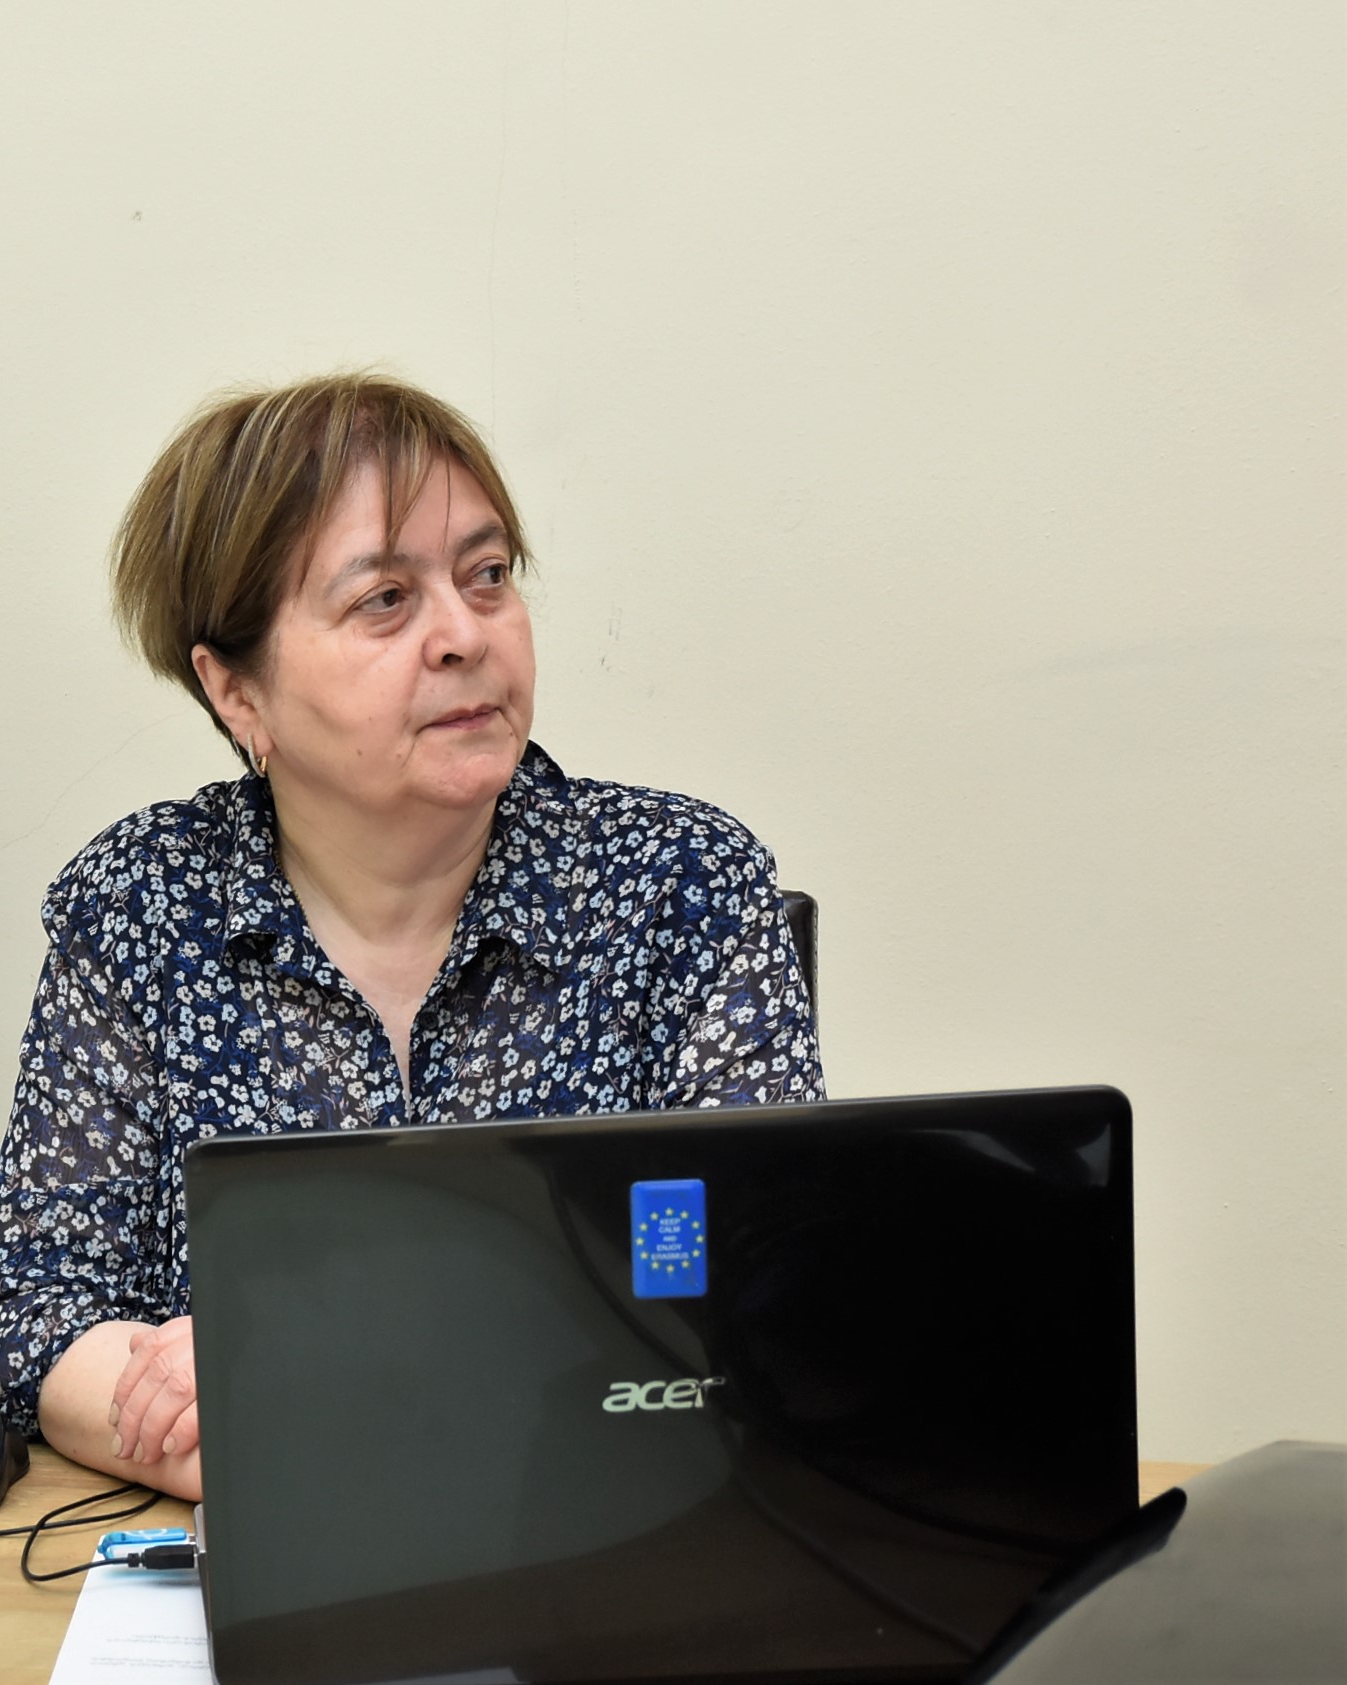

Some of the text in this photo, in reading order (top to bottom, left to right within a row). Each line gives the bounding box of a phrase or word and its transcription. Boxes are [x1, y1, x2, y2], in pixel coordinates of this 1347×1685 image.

[659, 1218, 681, 1226] KEEP
[658, 1226, 681, 1234] CALM
[656, 1243, 683, 1252] ENJOY
[602, 1376, 726, 1413] acer
